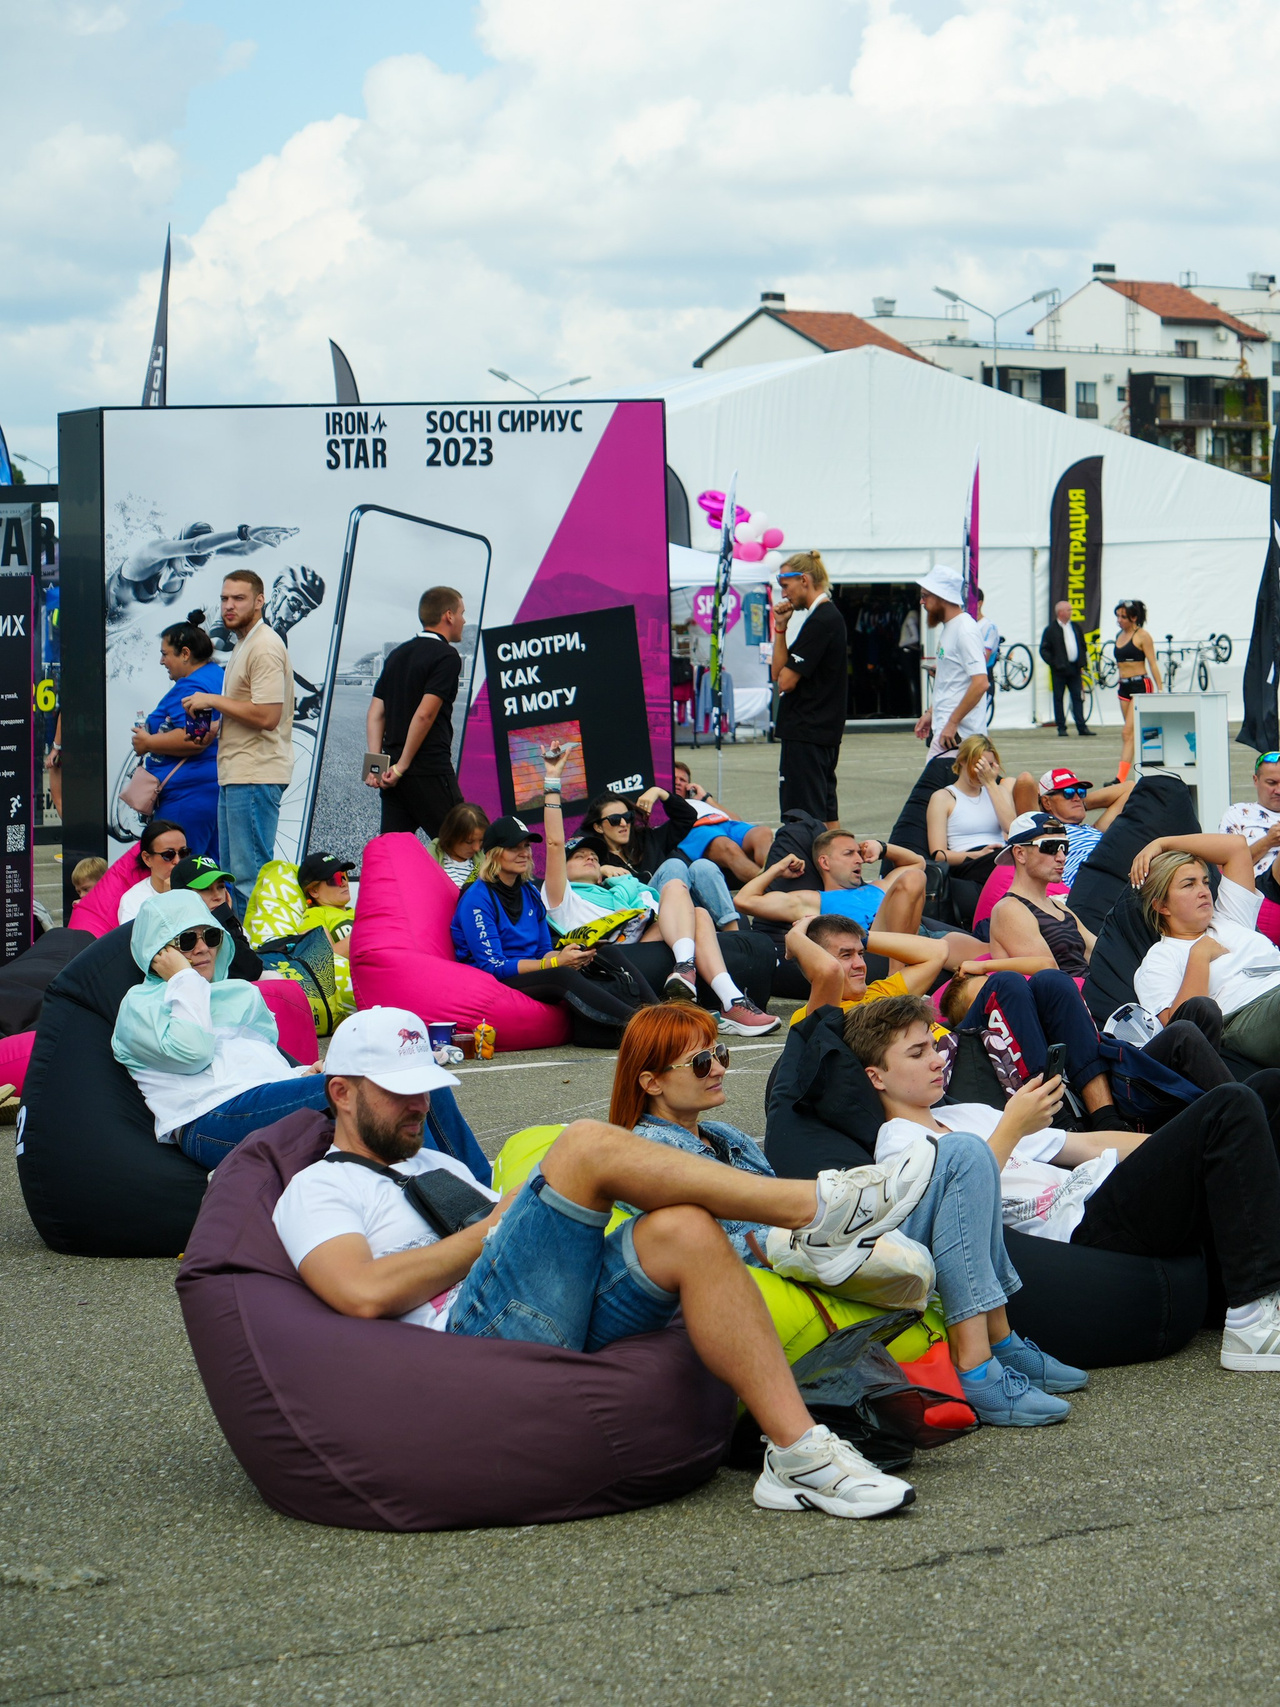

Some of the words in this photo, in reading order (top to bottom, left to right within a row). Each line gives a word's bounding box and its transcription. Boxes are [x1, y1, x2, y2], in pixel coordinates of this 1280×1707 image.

[325, 411, 368, 435] IRON
[426, 410, 491, 433] SOCHI
[498, 409, 583, 432] СИРИУС
[326, 438, 387, 469] STAR
[426, 437, 493, 467] 2023
[1068, 488, 1090, 622] РЕГИСТРАЦИЯ
[697, 594, 737, 616] SHP
[497, 632, 586, 662] СМОТРИ,
[500, 665, 541, 689] КАК
[503, 697, 518, 716] Я
[521, 686, 577, 713] МОГУ
[606, 774, 644, 794] TELE2
